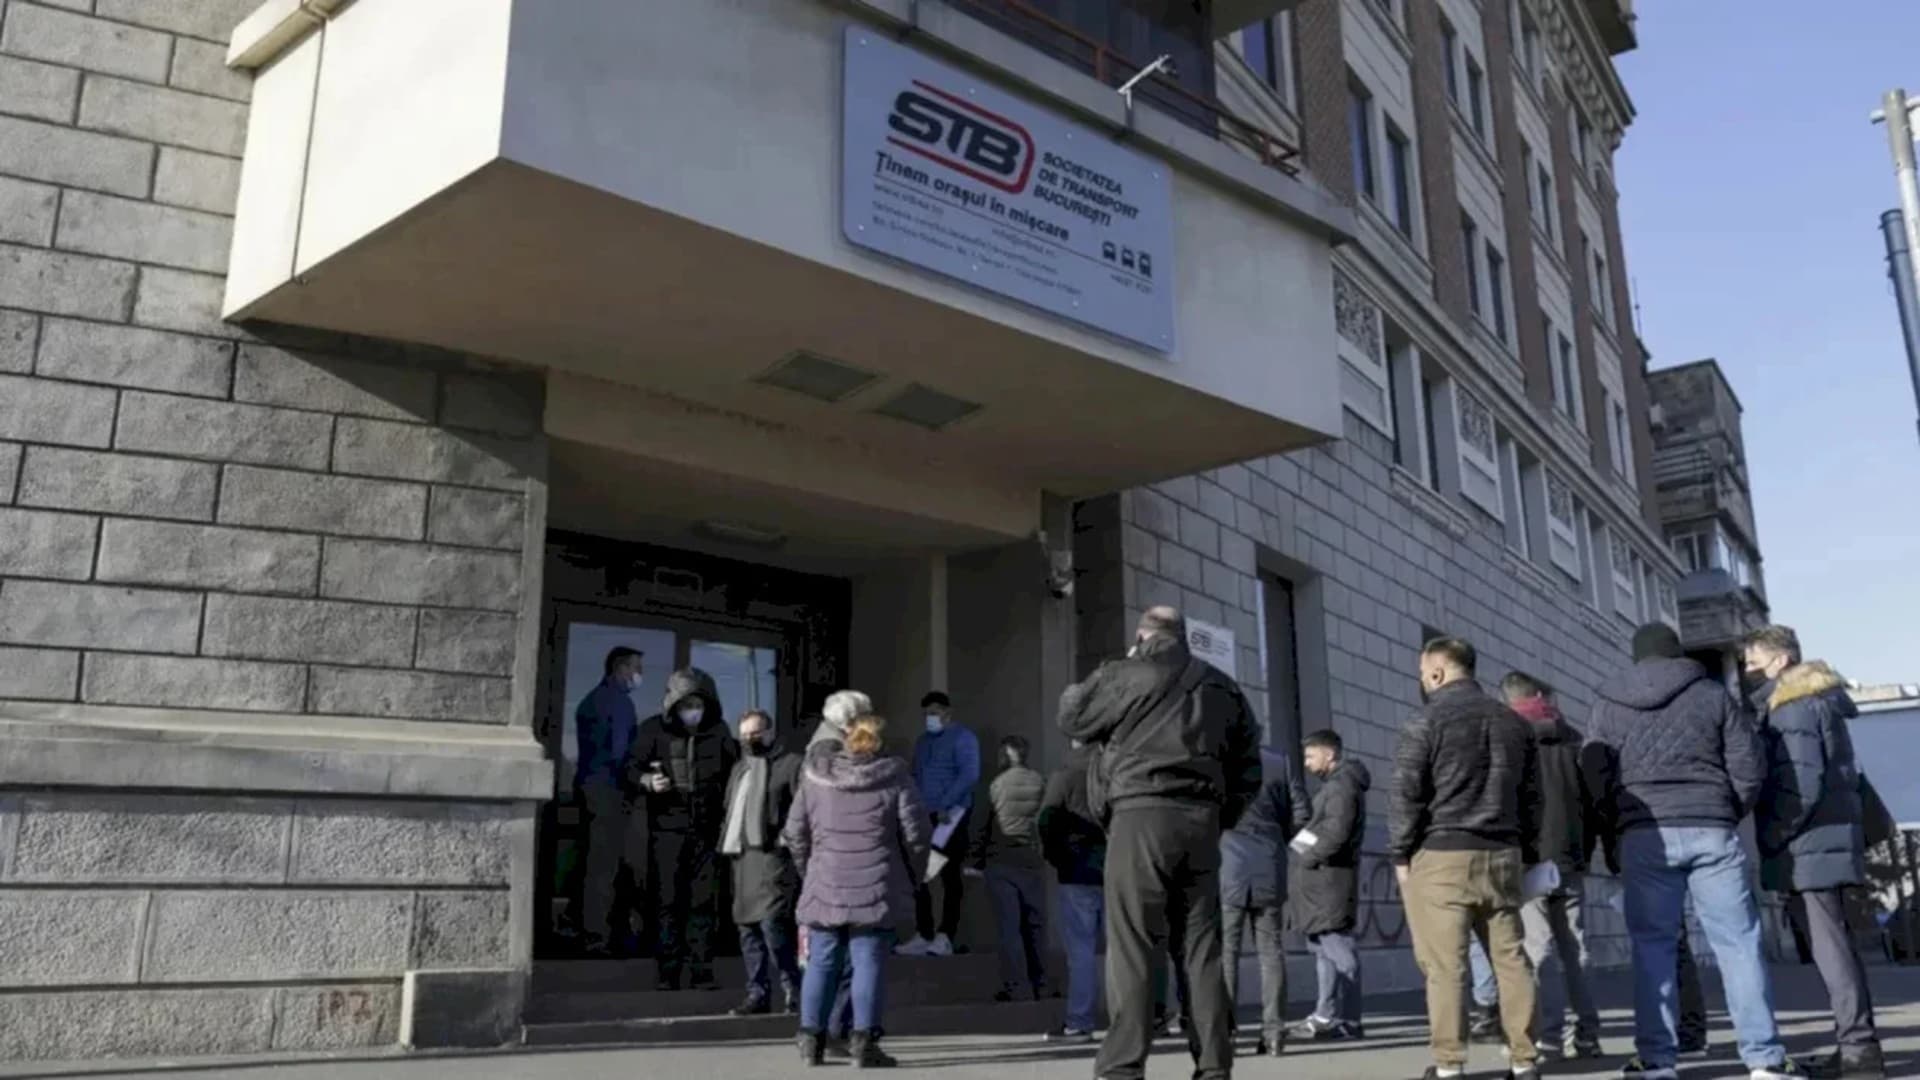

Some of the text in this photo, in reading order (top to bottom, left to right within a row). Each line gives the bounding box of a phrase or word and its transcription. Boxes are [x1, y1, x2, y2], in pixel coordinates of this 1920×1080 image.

[888, 92, 1021, 175] STB
[1038, 168, 1139, 219] DE TRANSPORT
[1043, 152, 1122, 195] SOCIETATEA
